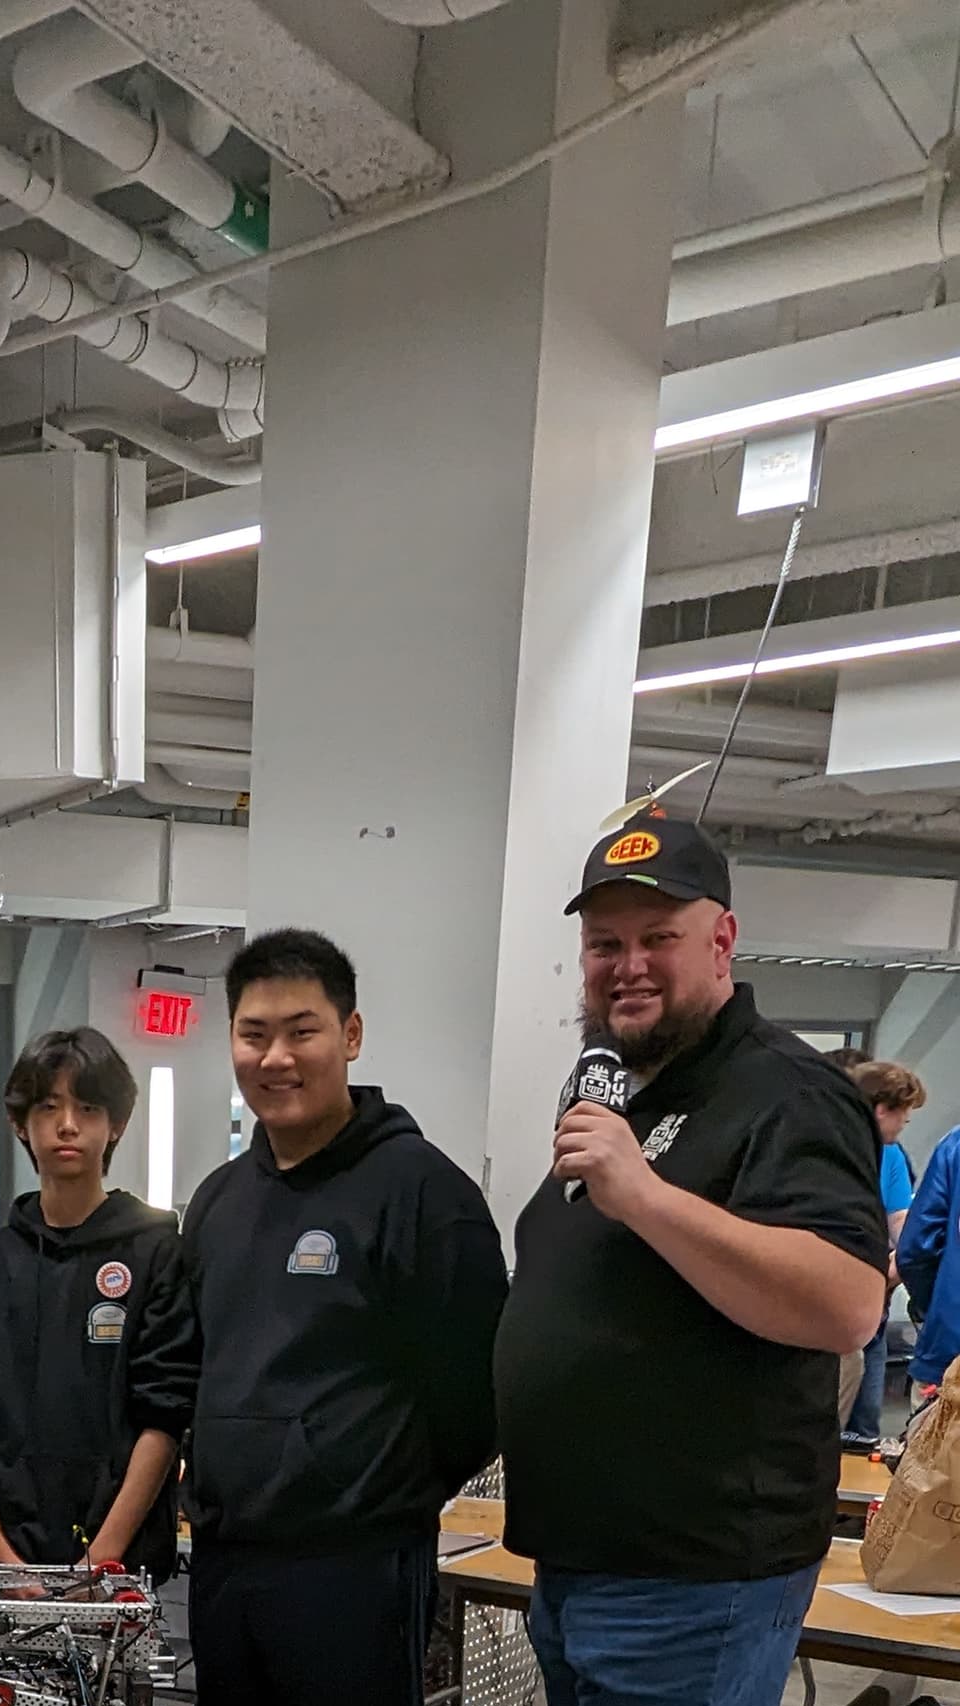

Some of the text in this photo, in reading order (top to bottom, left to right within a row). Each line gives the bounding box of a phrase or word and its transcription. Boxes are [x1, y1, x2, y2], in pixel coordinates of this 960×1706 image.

[610, 837, 653, 859] GEEK
[146, 993, 191, 1036] EXIT
[609, 1070, 628, 1107] FUN
